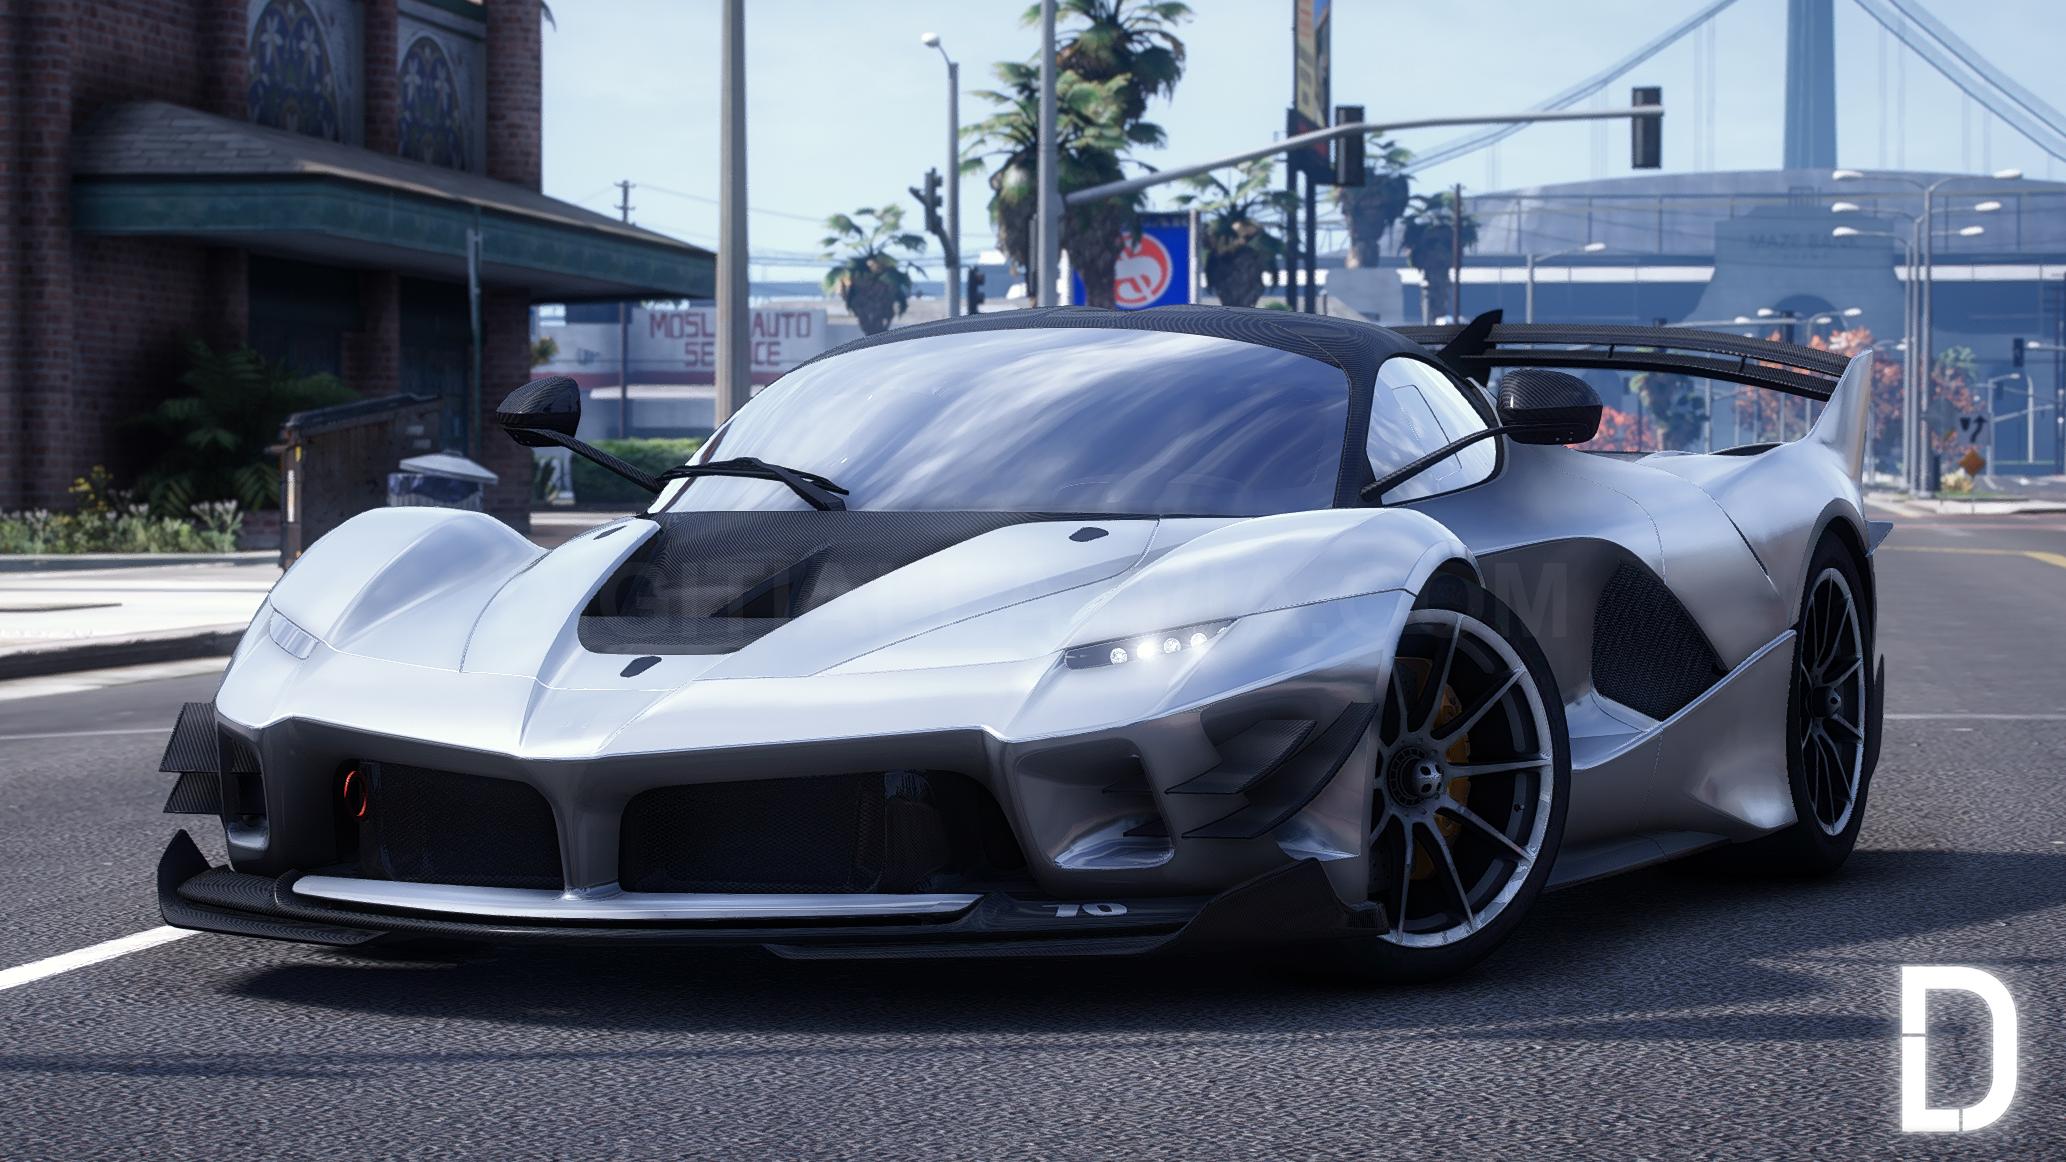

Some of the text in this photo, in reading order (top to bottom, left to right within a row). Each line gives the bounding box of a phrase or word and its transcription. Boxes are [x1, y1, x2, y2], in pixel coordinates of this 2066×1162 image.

[651, 311, 811, 338] MOSL AUTO
[684, 341, 781, 367] SECE
